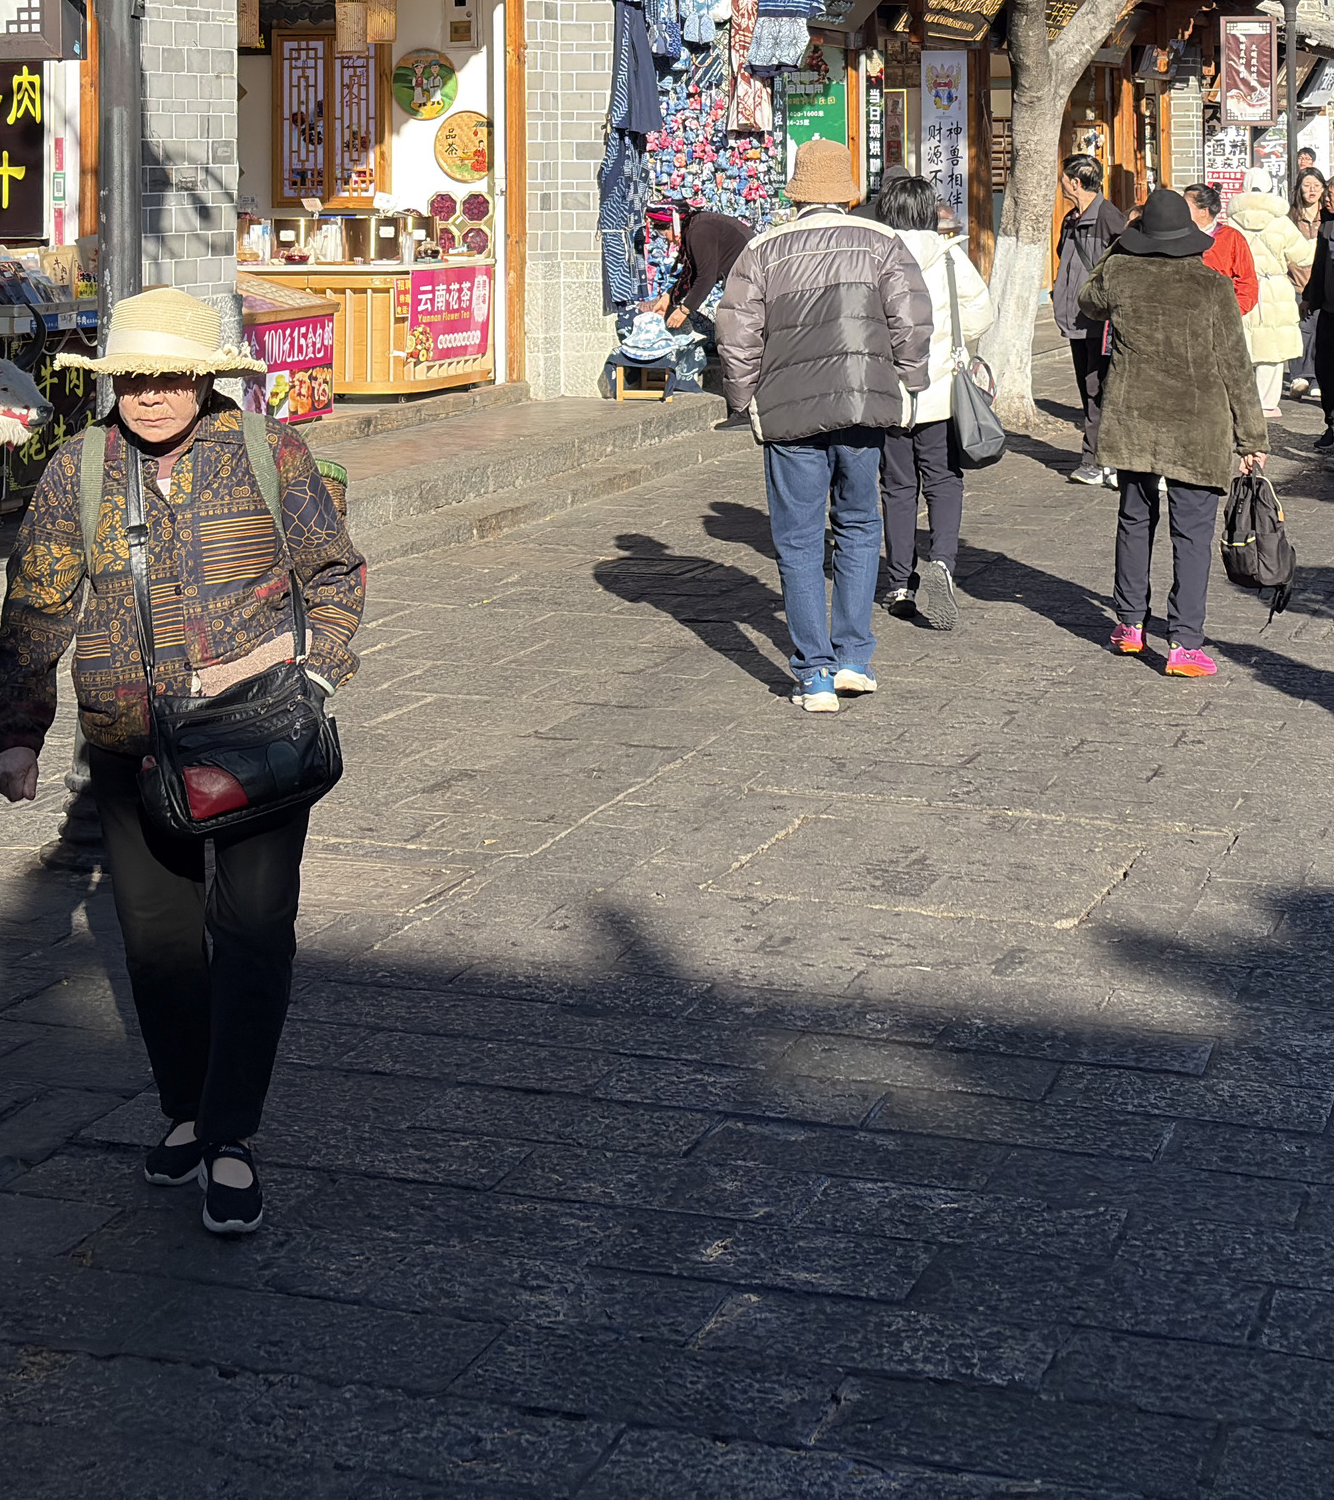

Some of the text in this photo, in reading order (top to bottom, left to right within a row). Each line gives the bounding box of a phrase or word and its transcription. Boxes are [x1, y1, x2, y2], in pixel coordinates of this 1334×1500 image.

[445, 128, 459, 156] 品茶
[946, 120, 964, 213] 神兽相伴
[442, 311, 460, 321] Flower
[461, 310, 470, 319] Tea
[263, 319, 333, 365] 100元15盒包邮
